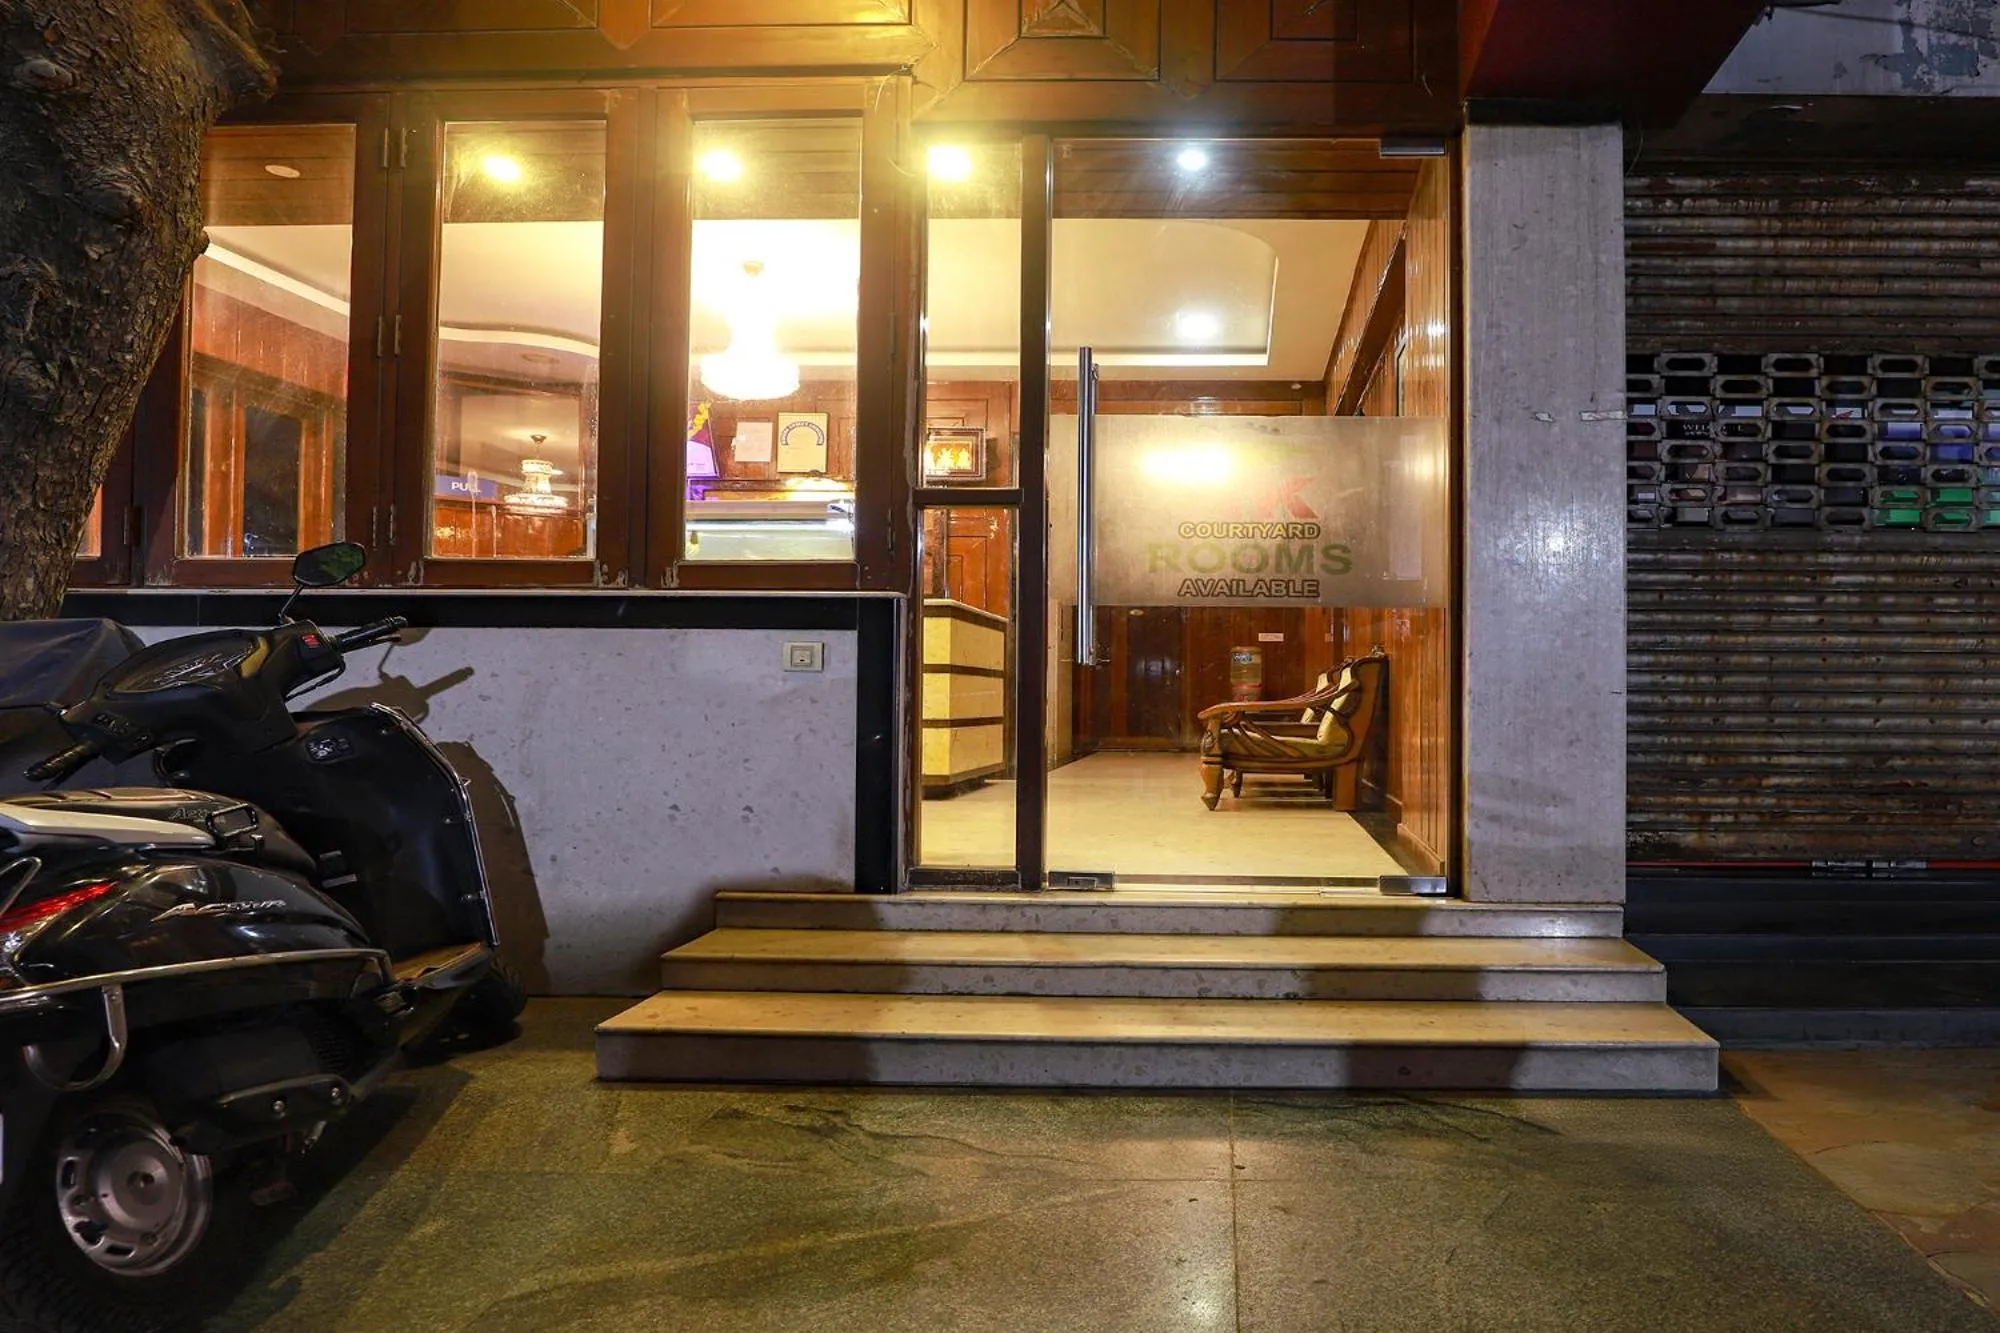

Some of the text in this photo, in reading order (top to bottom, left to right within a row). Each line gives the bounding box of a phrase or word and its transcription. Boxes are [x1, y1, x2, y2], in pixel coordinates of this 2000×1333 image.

[1178, 521, 1321, 539] COURTYARD
[1148, 542, 1353, 575] ROOMS
[1177, 578, 1320, 598] AVAILABLE
